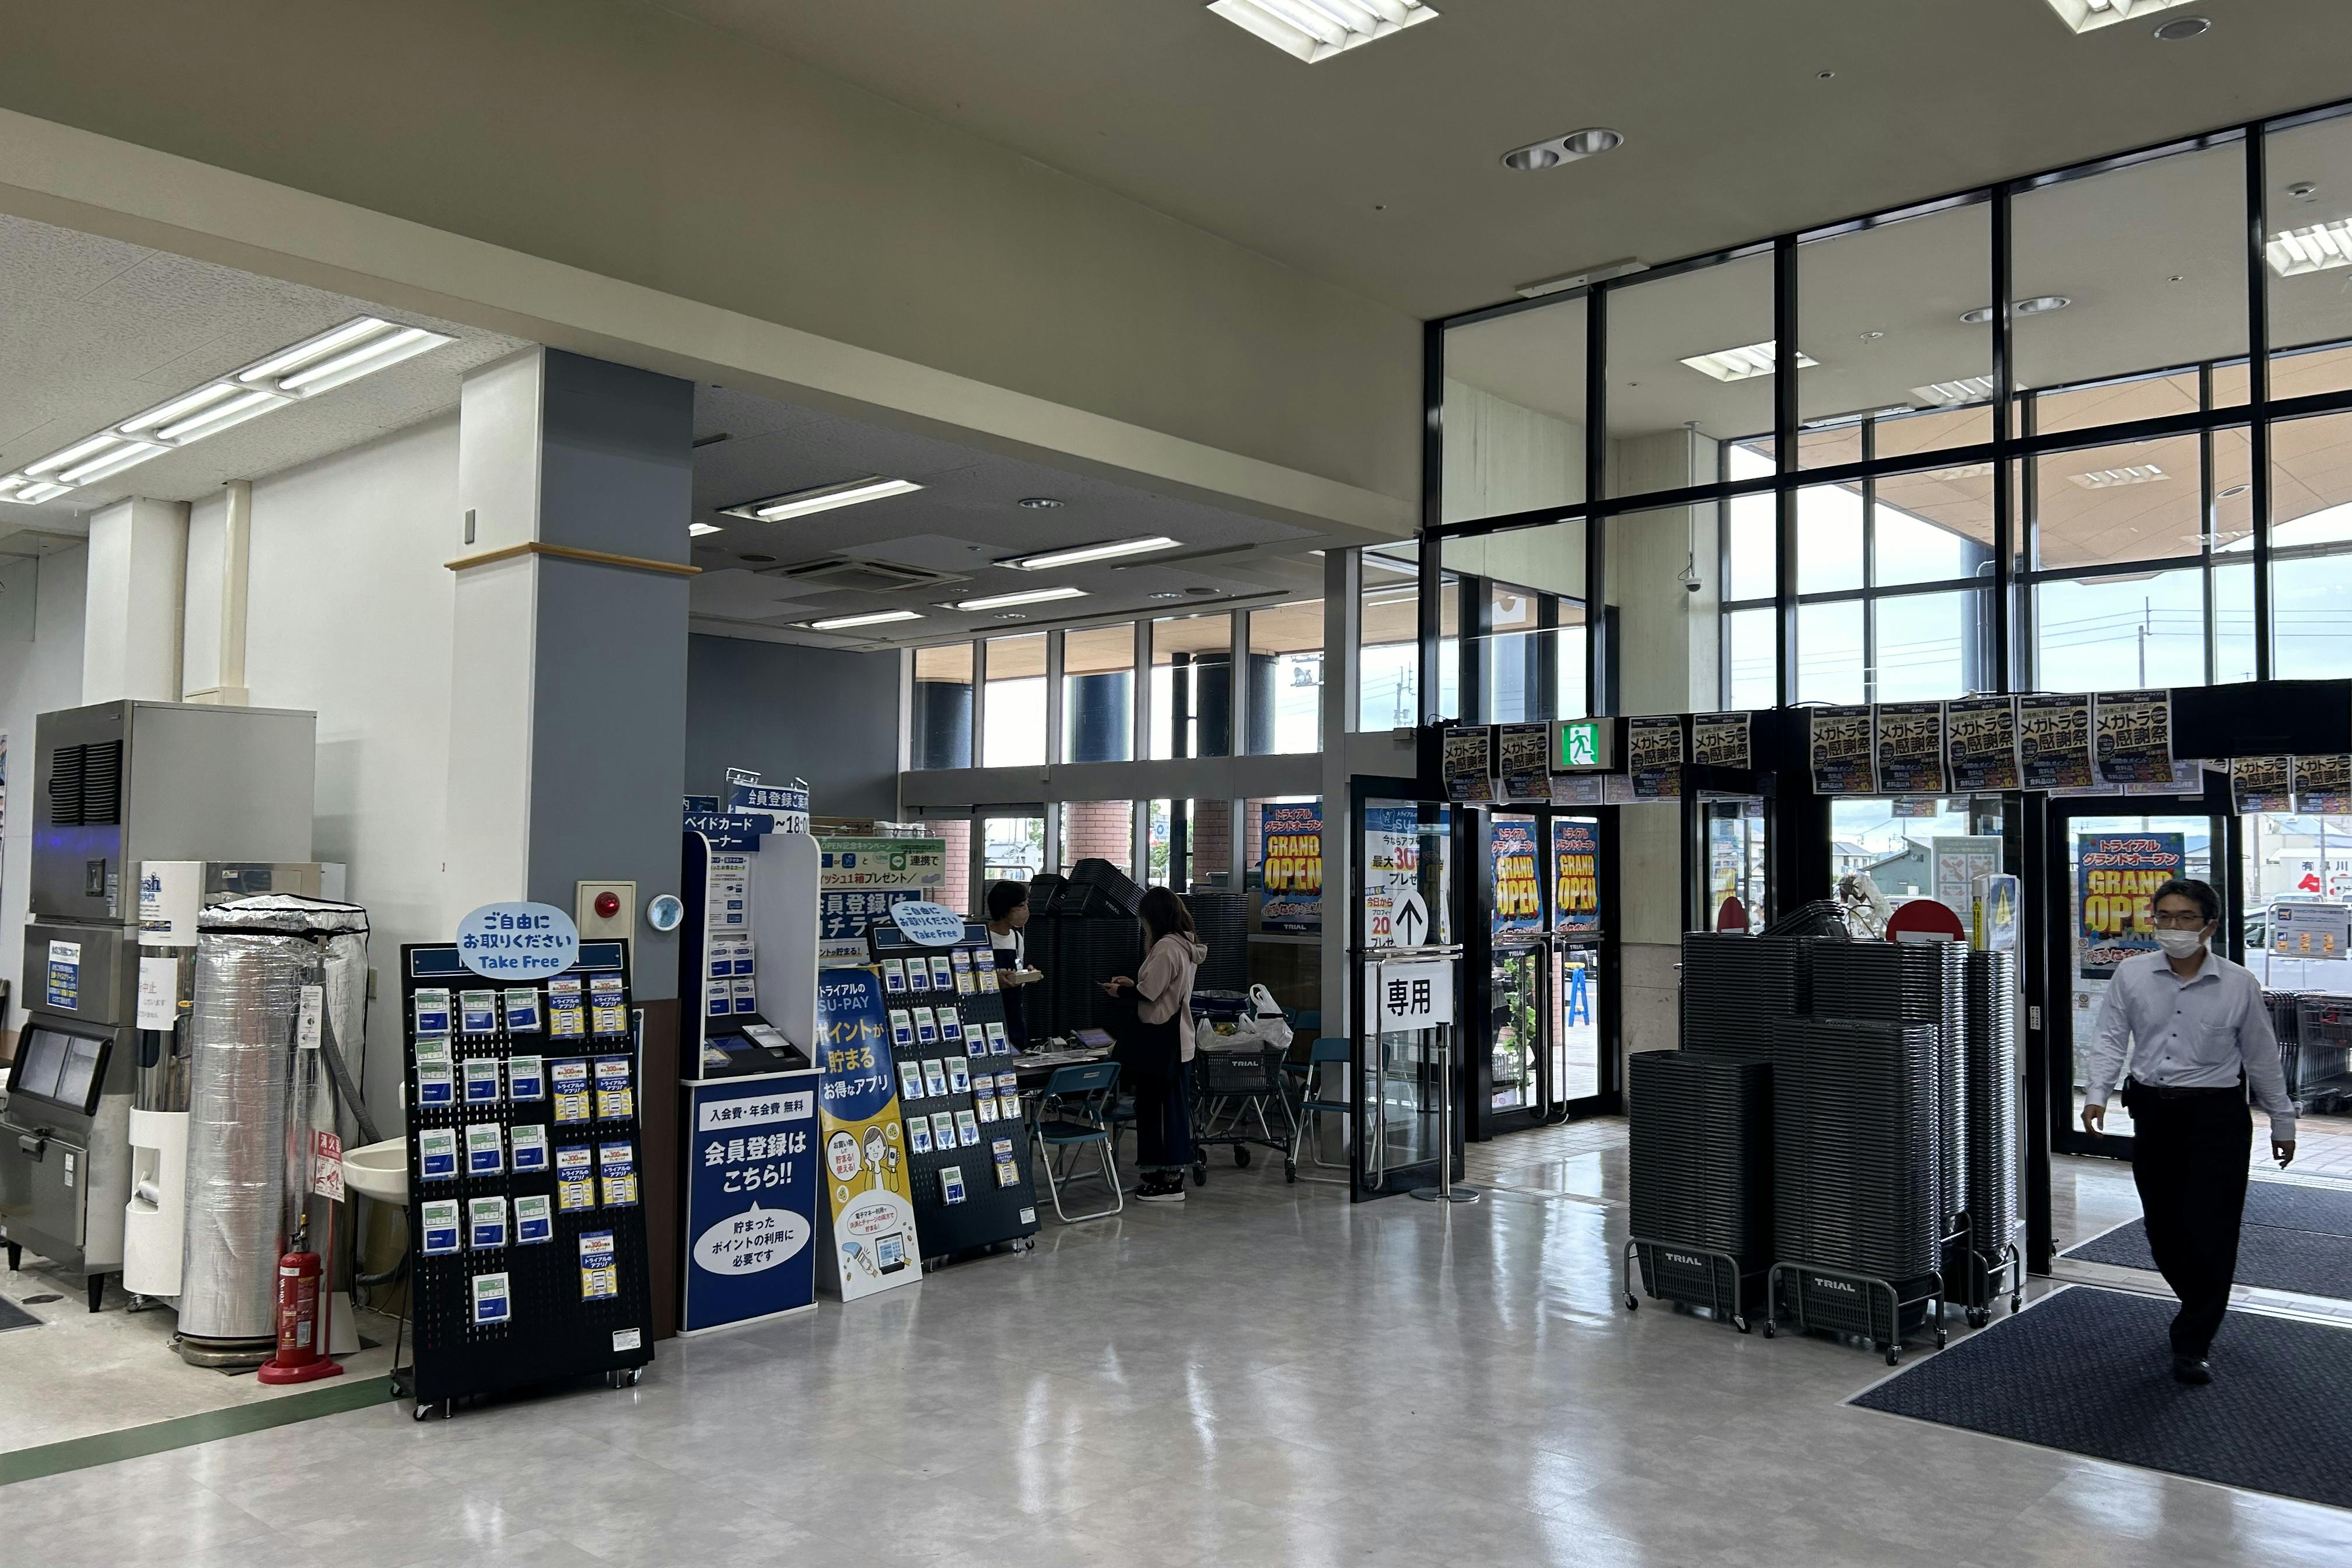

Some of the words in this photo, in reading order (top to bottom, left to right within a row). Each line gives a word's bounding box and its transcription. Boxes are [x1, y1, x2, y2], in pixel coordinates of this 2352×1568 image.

[1950, 717, 1996, 738] メガトラ
[2021, 715, 2071, 735] メガトラ
[2096, 711, 2150, 732] メガトラ
[1814, 724, 1856, 743] メガトラ
[1880, 721, 1925, 740] メガトラ
[2116, 725, 2168, 747] 感謝祭
[1502, 740, 1536, 756] メガトラ
[1631, 734, 1669, 751] メガトラ
[1696, 731, 1735, 748] メガトラ
[1828, 737, 1870, 756] 感謝祭
[1896, 735, 1940, 754] 感謝祭
[1967, 731, 2013, 752] 感謝祭
[2039, 729, 2088, 750] 感謝祭
[1514, 751, 1546, 768] 感謝祭
[1644, 746, 1680, 764] 感謝祭
[1709, 743, 1748, 762] 感謝祭
[2234, 760, 2274, 775] メガトラ
[2295, 758, 2337, 773] メガトラ
[2248, 771, 2287, 786] 感謝祭
[2310, 769, 2350, 785] 感謝祭
[1275, 808, 1312, 820] トライアル
[685, 816, 752, 831] ペイドカード
[1265, 820, 1322, 832] グランドオープン
[1499, 828, 1527, 840] トライアル
[1563, 827, 1588, 839] トライアル
[1268, 836, 1320, 856] GRAND
[1556, 839, 1595, 851] グランドオープン
[2100, 839, 2161, 852] トライアル
[910, 856, 939, 866] 連携で
[1497, 856, 1534, 879] GRAND
[1560, 855, 1594, 876] GRAND
[2082, 853, 2180, 866] グランドオープン
[1265, 858, 1321, 890] OPEN
[1497, 879, 1539, 915] OPEN
[1558, 877, 1597, 909] OPEN
[902, 906, 940, 915] ご自由に
[1105, 900, 1120, 915] TRIAL
[1367, 897, 1394, 907] 今日から
[484, 912, 550, 929] ご自由に
[899, 916, 958, 926] お取りください
[2085, 895, 2154, 933] OPE
[464, 933, 571, 949] お取りください
[913, 930, 936, 940] Take
[937, 929, 958, 938] Free
[479, 955, 518, 968] Take
[523, 956, 559, 968] Free
[819, 984, 865, 998] トライアルの
[1387, 979, 1430, 1017] 専用
[818, 996, 869, 1012] SU-PAY
[817, 1019, 884, 1045] ポイントが
[828, 1047, 874, 1073] 貯まる
[824, 1074, 888, 1100] お得なアプリ
[710, 1102, 780, 1122] 入会費・年会費
[783, 1100, 803, 1113] 無料
[705, 1131, 807, 1167] 会員登録は
[834, 1139, 853, 1149] お買い物
[835, 1153, 855, 1164] 貯まる!
[723, 1162, 792, 1192] こちら!!
[836, 1163, 856, 1174] 使える!
[856, 1207, 887, 1219] 電子マネー利用で
[733, 1216, 775, 1234] 貯まった
[865, 1223, 880, 1233] 貯まる!
[712, 1230, 794, 1254] ポイントの利用に
[733, 1250, 774, 1267] 必要です
[1665, 1253, 1702, 1266] TRIAL
[1815, 1278, 1856, 1293] TRIAL
